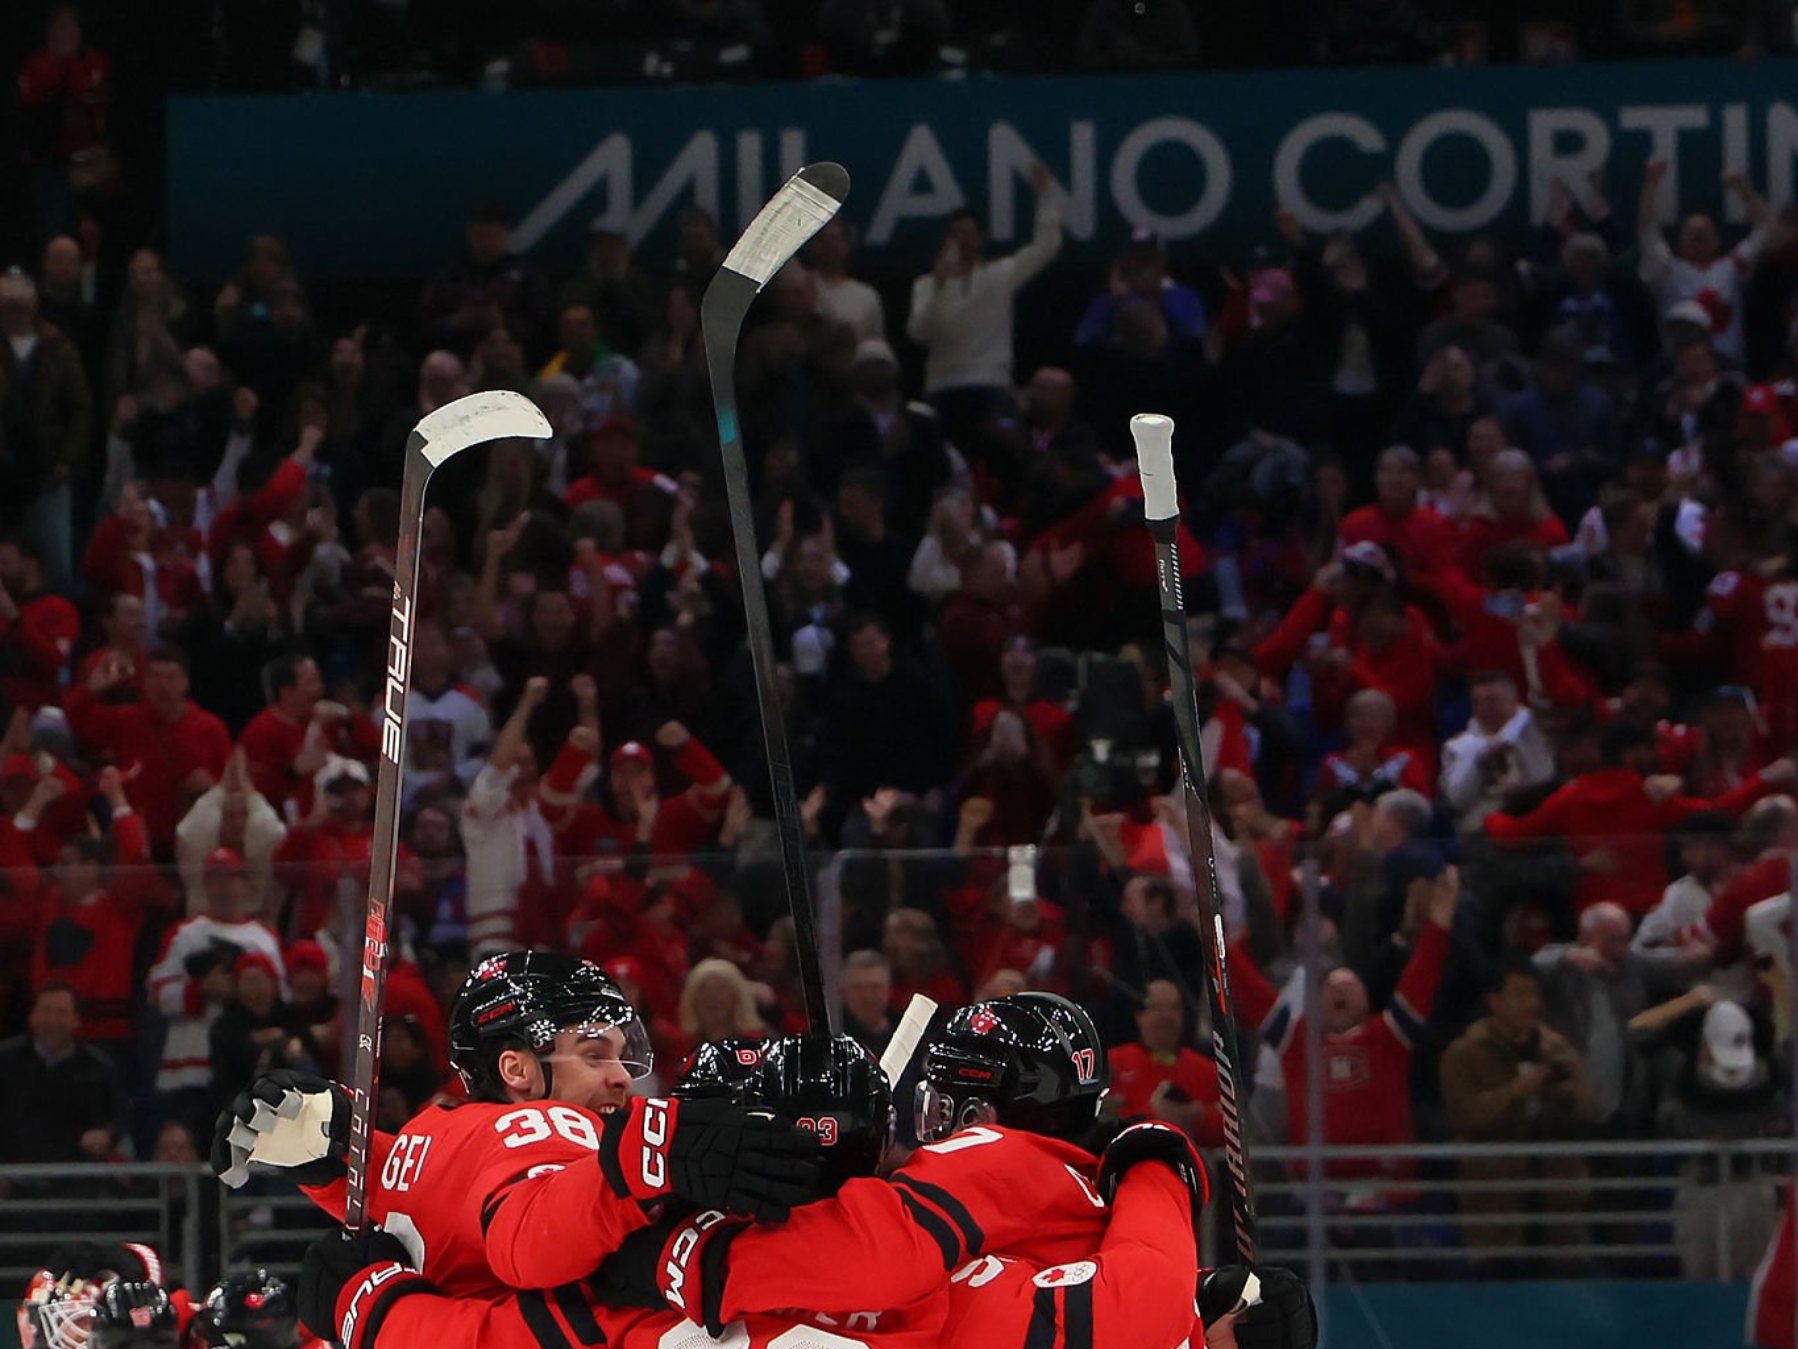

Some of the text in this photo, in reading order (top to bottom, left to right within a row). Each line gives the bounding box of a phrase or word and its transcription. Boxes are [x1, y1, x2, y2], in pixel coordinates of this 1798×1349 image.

[381, 595, 411, 765] TRUE
[957, 1067, 992, 1079] CCM
[1071, 1047, 1095, 1081] 17
[494, 1106, 601, 1150] 38
[665, 1209, 726, 1309] CCM
